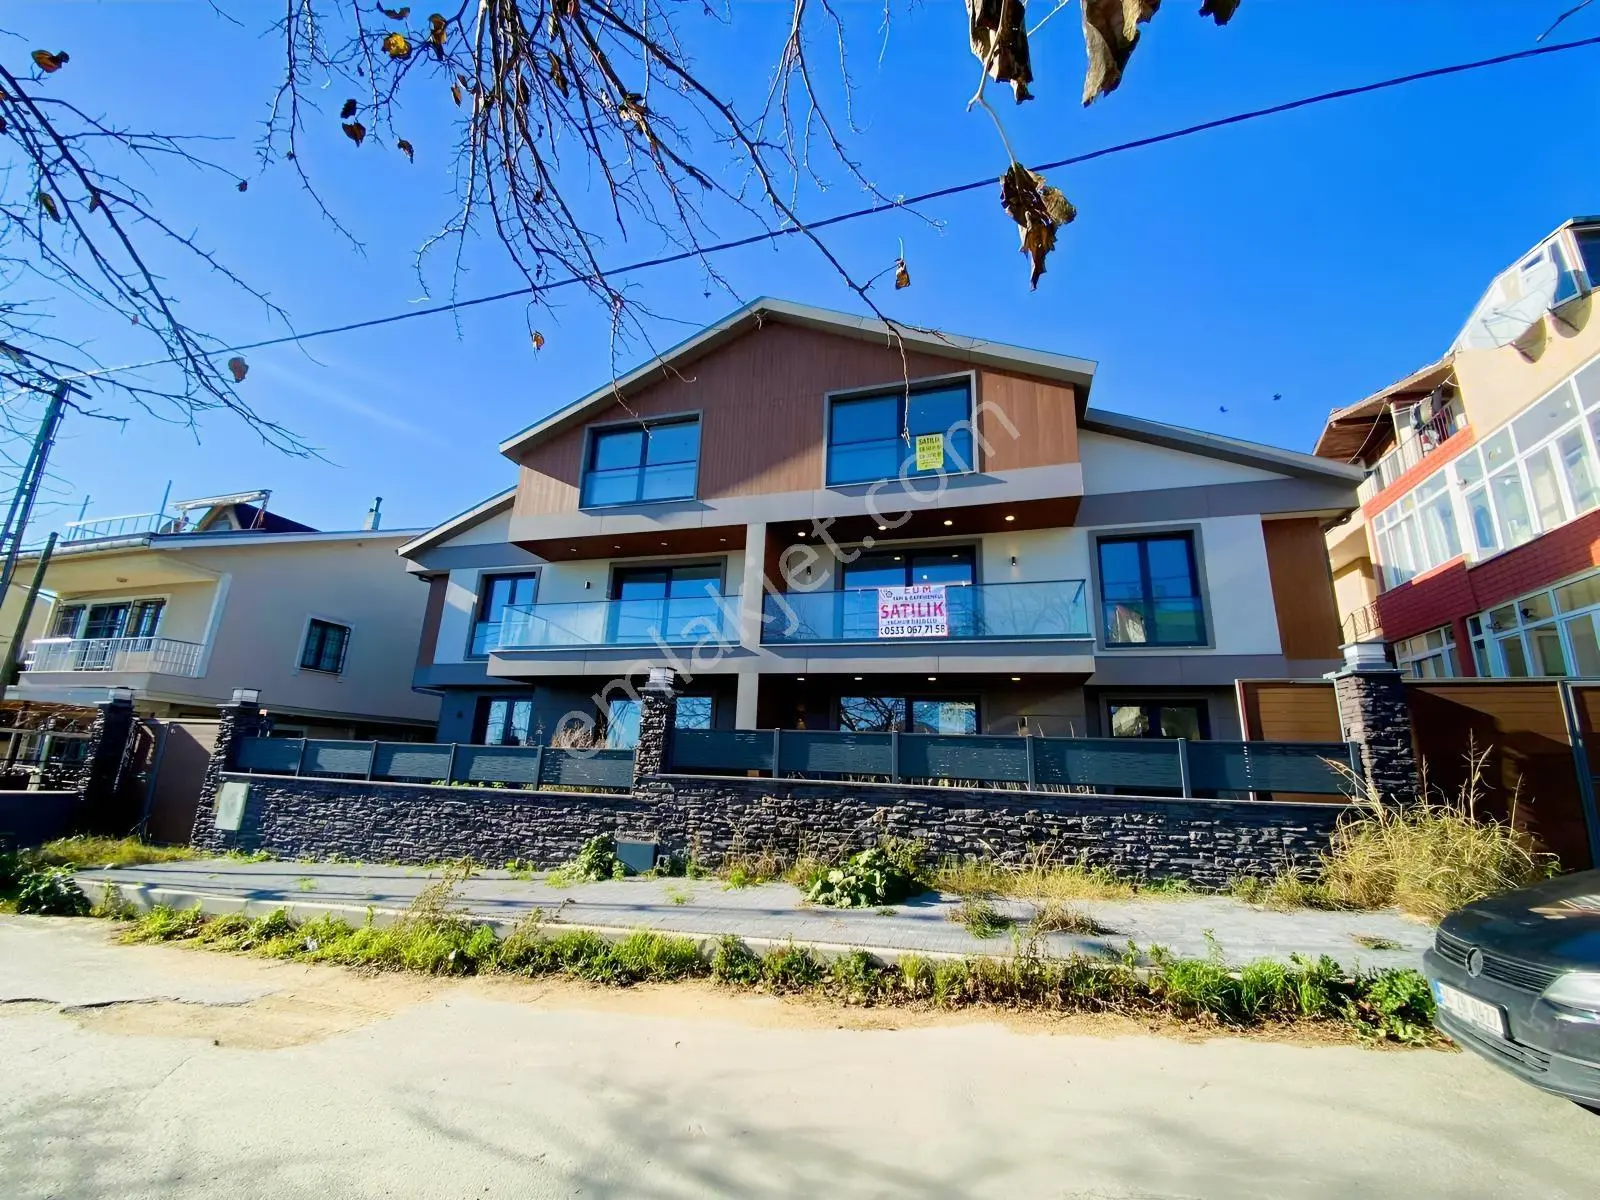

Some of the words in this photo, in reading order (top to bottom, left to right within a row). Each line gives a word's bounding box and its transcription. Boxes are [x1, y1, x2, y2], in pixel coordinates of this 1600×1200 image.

[880, 601, 945, 619] SATILIK
[884, 626, 905, 635] 0533
[906, 625, 922, 634] 067
[925, 625, 933, 634] 71
